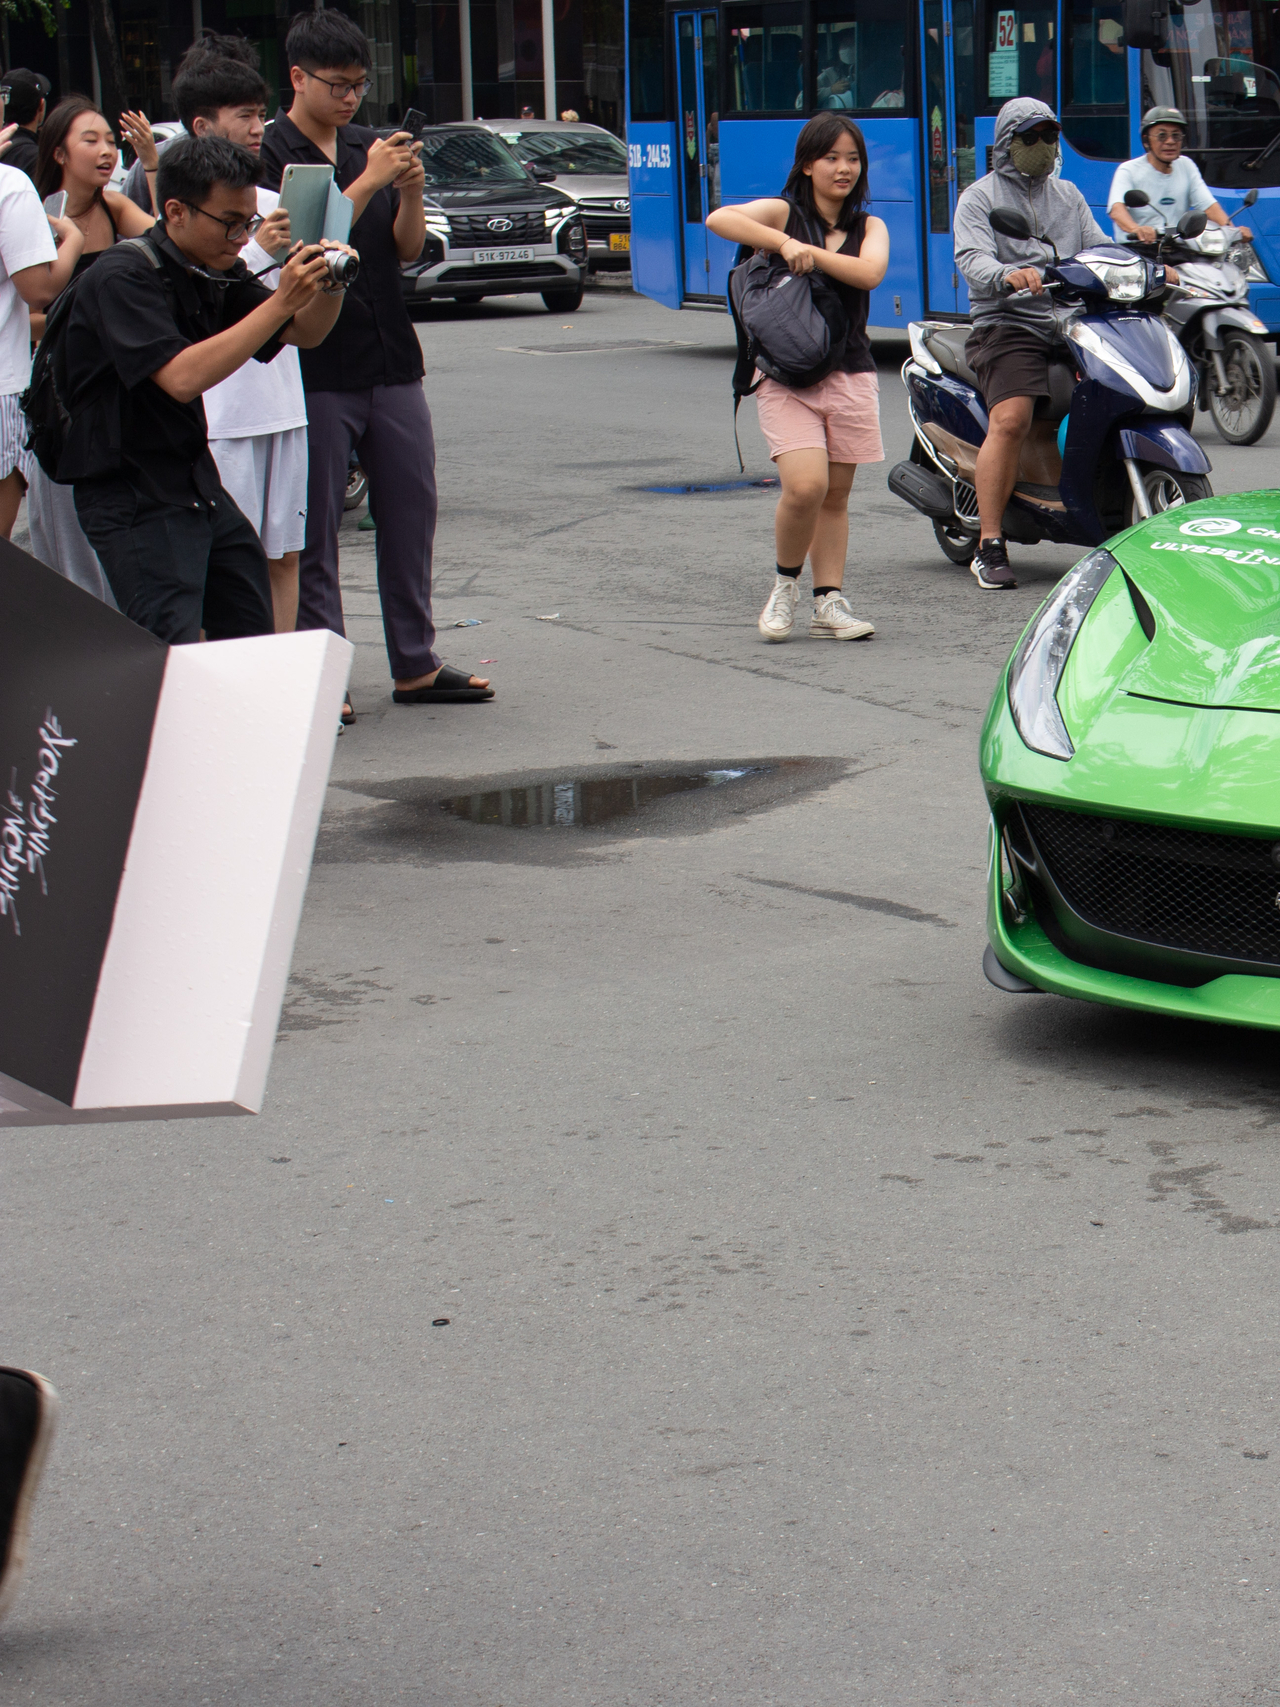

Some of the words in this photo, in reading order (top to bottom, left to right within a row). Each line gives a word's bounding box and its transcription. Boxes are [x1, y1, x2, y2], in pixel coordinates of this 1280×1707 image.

[998, 14, 1014, 47] 52
[628, 144, 642, 168] 51B
[646, 144, 671, 168] 244.53
[478, 250, 529, 262] 51K-972.46
[1150, 541, 1244, 558] ULYSSE
[27, 705, 78, 896] SINGAPORE
